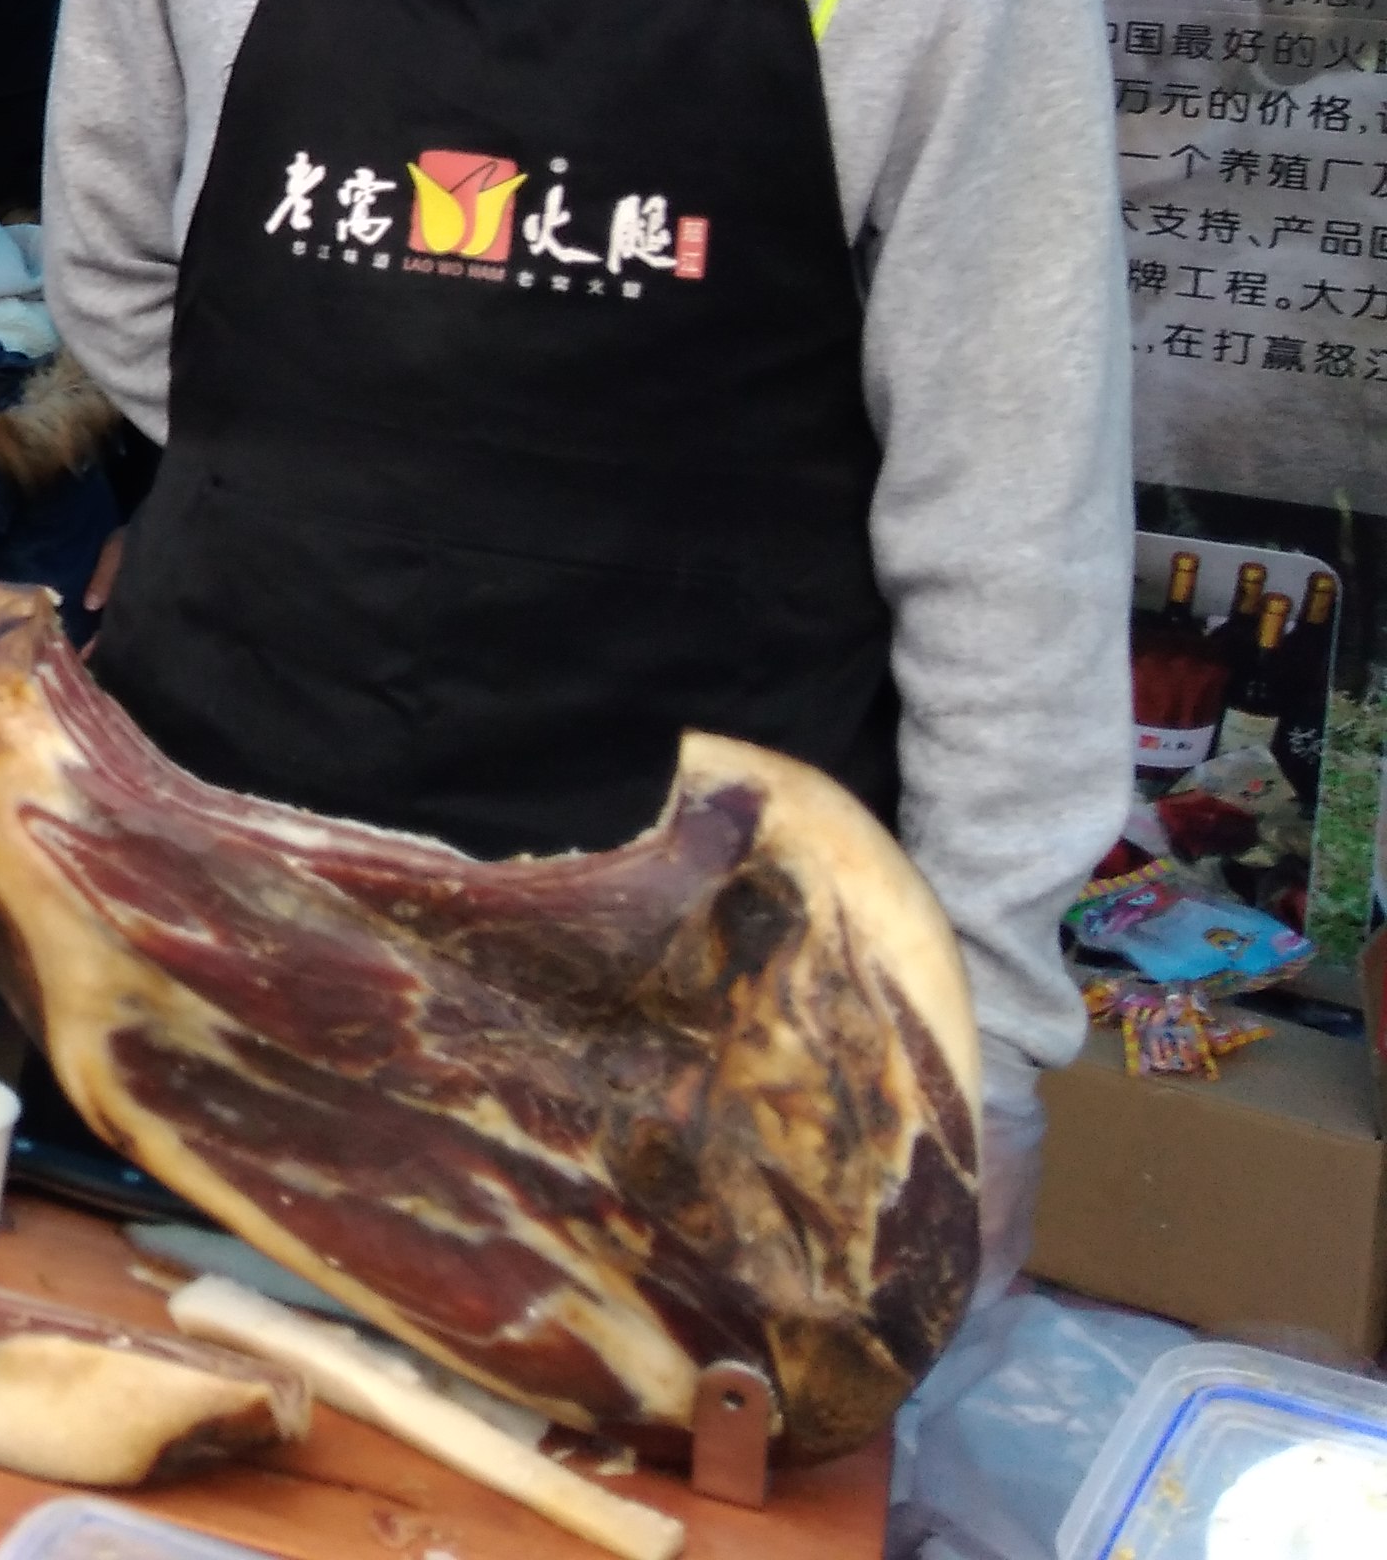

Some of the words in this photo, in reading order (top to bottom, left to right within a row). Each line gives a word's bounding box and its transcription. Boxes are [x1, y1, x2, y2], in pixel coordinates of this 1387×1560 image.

[1114, 76, 1387, 136] 万元的价格，
[1132, 323, 1387, 384] ，在打赢怒江
